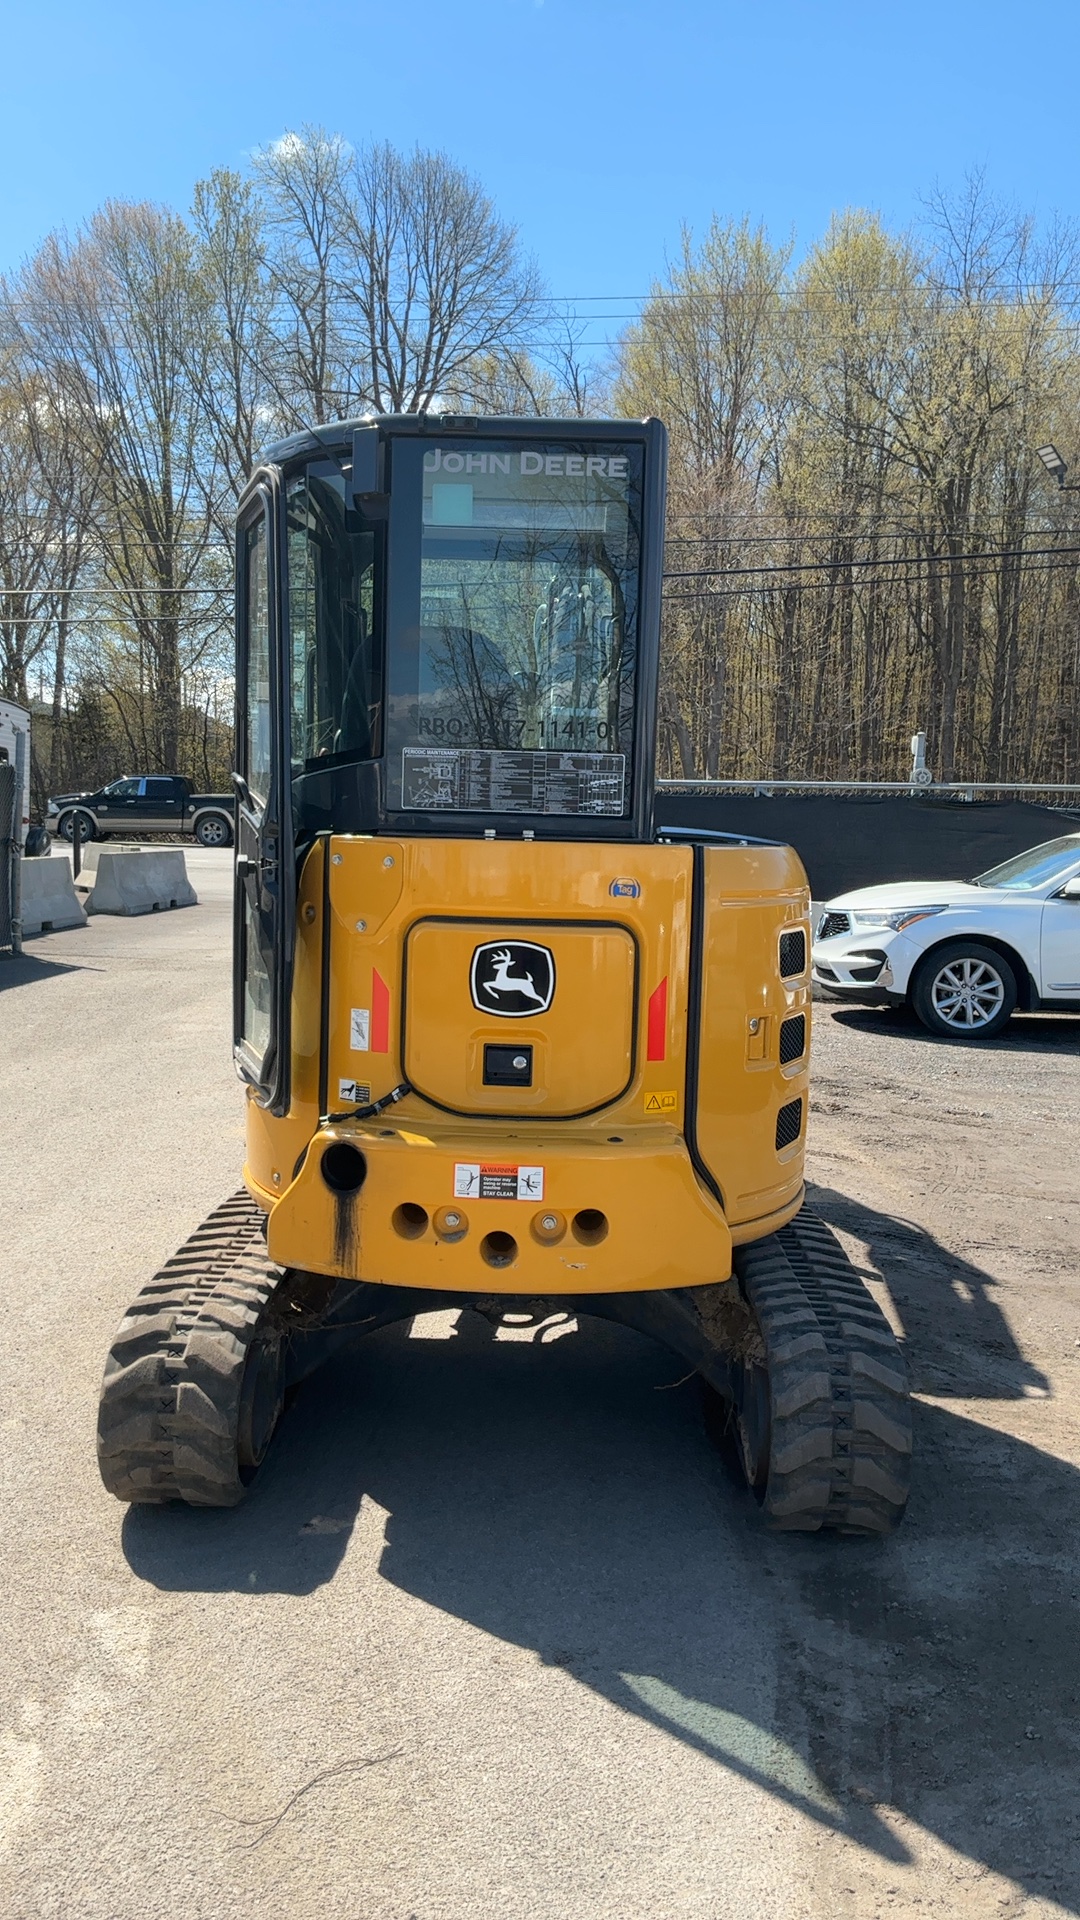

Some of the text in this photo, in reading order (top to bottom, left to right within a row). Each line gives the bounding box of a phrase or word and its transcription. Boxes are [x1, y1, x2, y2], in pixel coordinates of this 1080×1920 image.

[423, 448, 628, 478] JOHN DEERE
[418, 717, 469, 738] RBQ:
[618, 884, 633, 896] Tag
